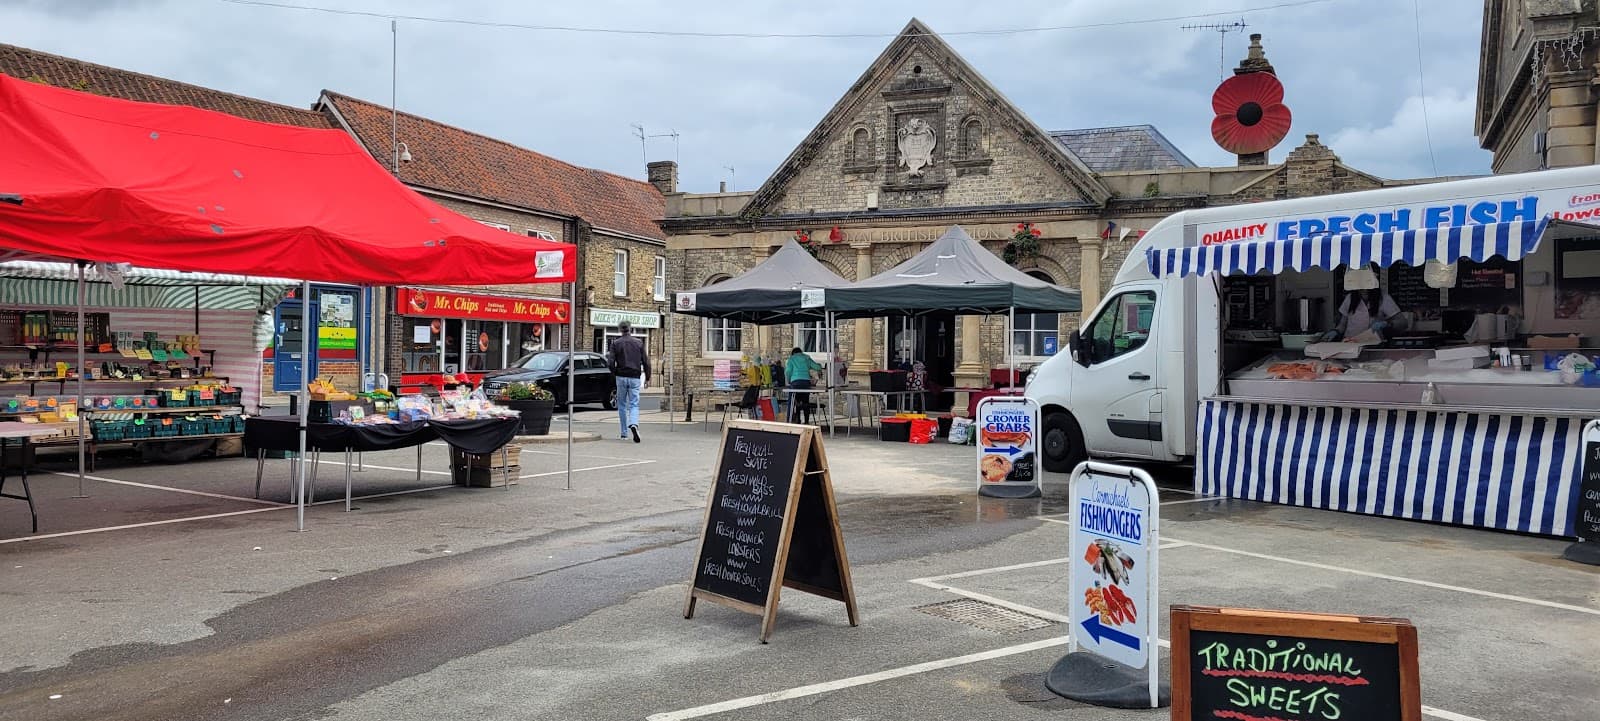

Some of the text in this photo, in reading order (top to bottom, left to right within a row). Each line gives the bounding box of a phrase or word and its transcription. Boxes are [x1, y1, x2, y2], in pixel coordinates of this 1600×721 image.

[1202, 196, 1539, 246] QUALITY FRESH FISH
[836, 230, 873, 242] OYAL
[881, 229, 937, 241] BRITISH
[434, 296, 480, 314] Mr. Chips
[513, 302, 551, 318] Mr. Chips
[641, 316, 657, 326] SHOP
[986, 423, 1030, 432] CRABS
[1080, 502, 1141, 540] FISHMONGERS
[1198, 640, 1361, 676] TRADITIONAL
[1226, 678, 1341, 719] SWEETS
